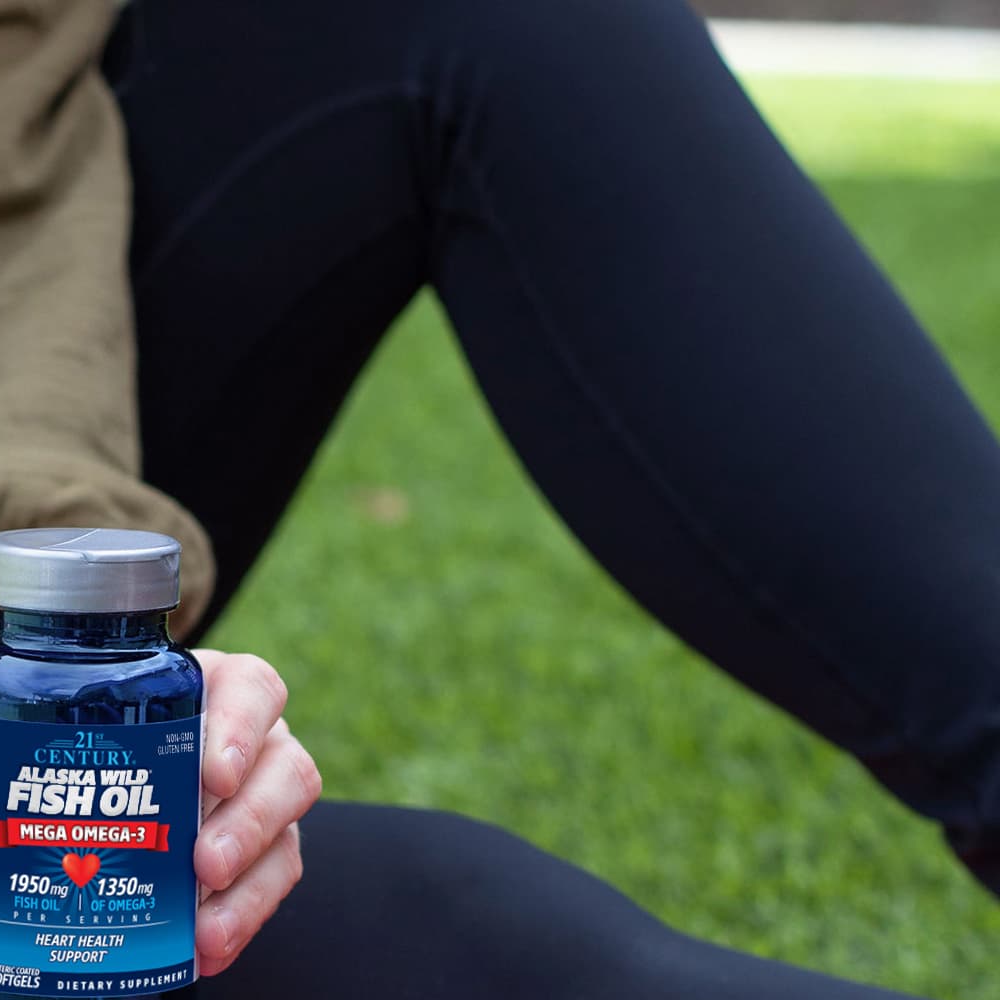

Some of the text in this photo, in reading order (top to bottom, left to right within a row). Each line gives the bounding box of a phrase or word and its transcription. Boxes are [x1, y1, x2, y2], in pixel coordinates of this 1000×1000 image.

[166, 731, 194, 743] NON-GMO
[157, 742, 195, 755] GLUTEN FREE
[17, 766, 149, 785] ALASKA WILD
[6, 781, 160, 816] FISH OIL
[20, 823, 146, 843] MEGA OMEGA-3
[14, 896, 61, 912] FISH OIL
[91, 897, 156, 912] OF OMEGA-3
[13, 911, 152, 924] PER SERVING
[35, 933, 125, 948] HEART HEALTH
[16, 967, 40, 976] COATED
[57, 969, 188, 991] DIETARY SUPPLEMENT
